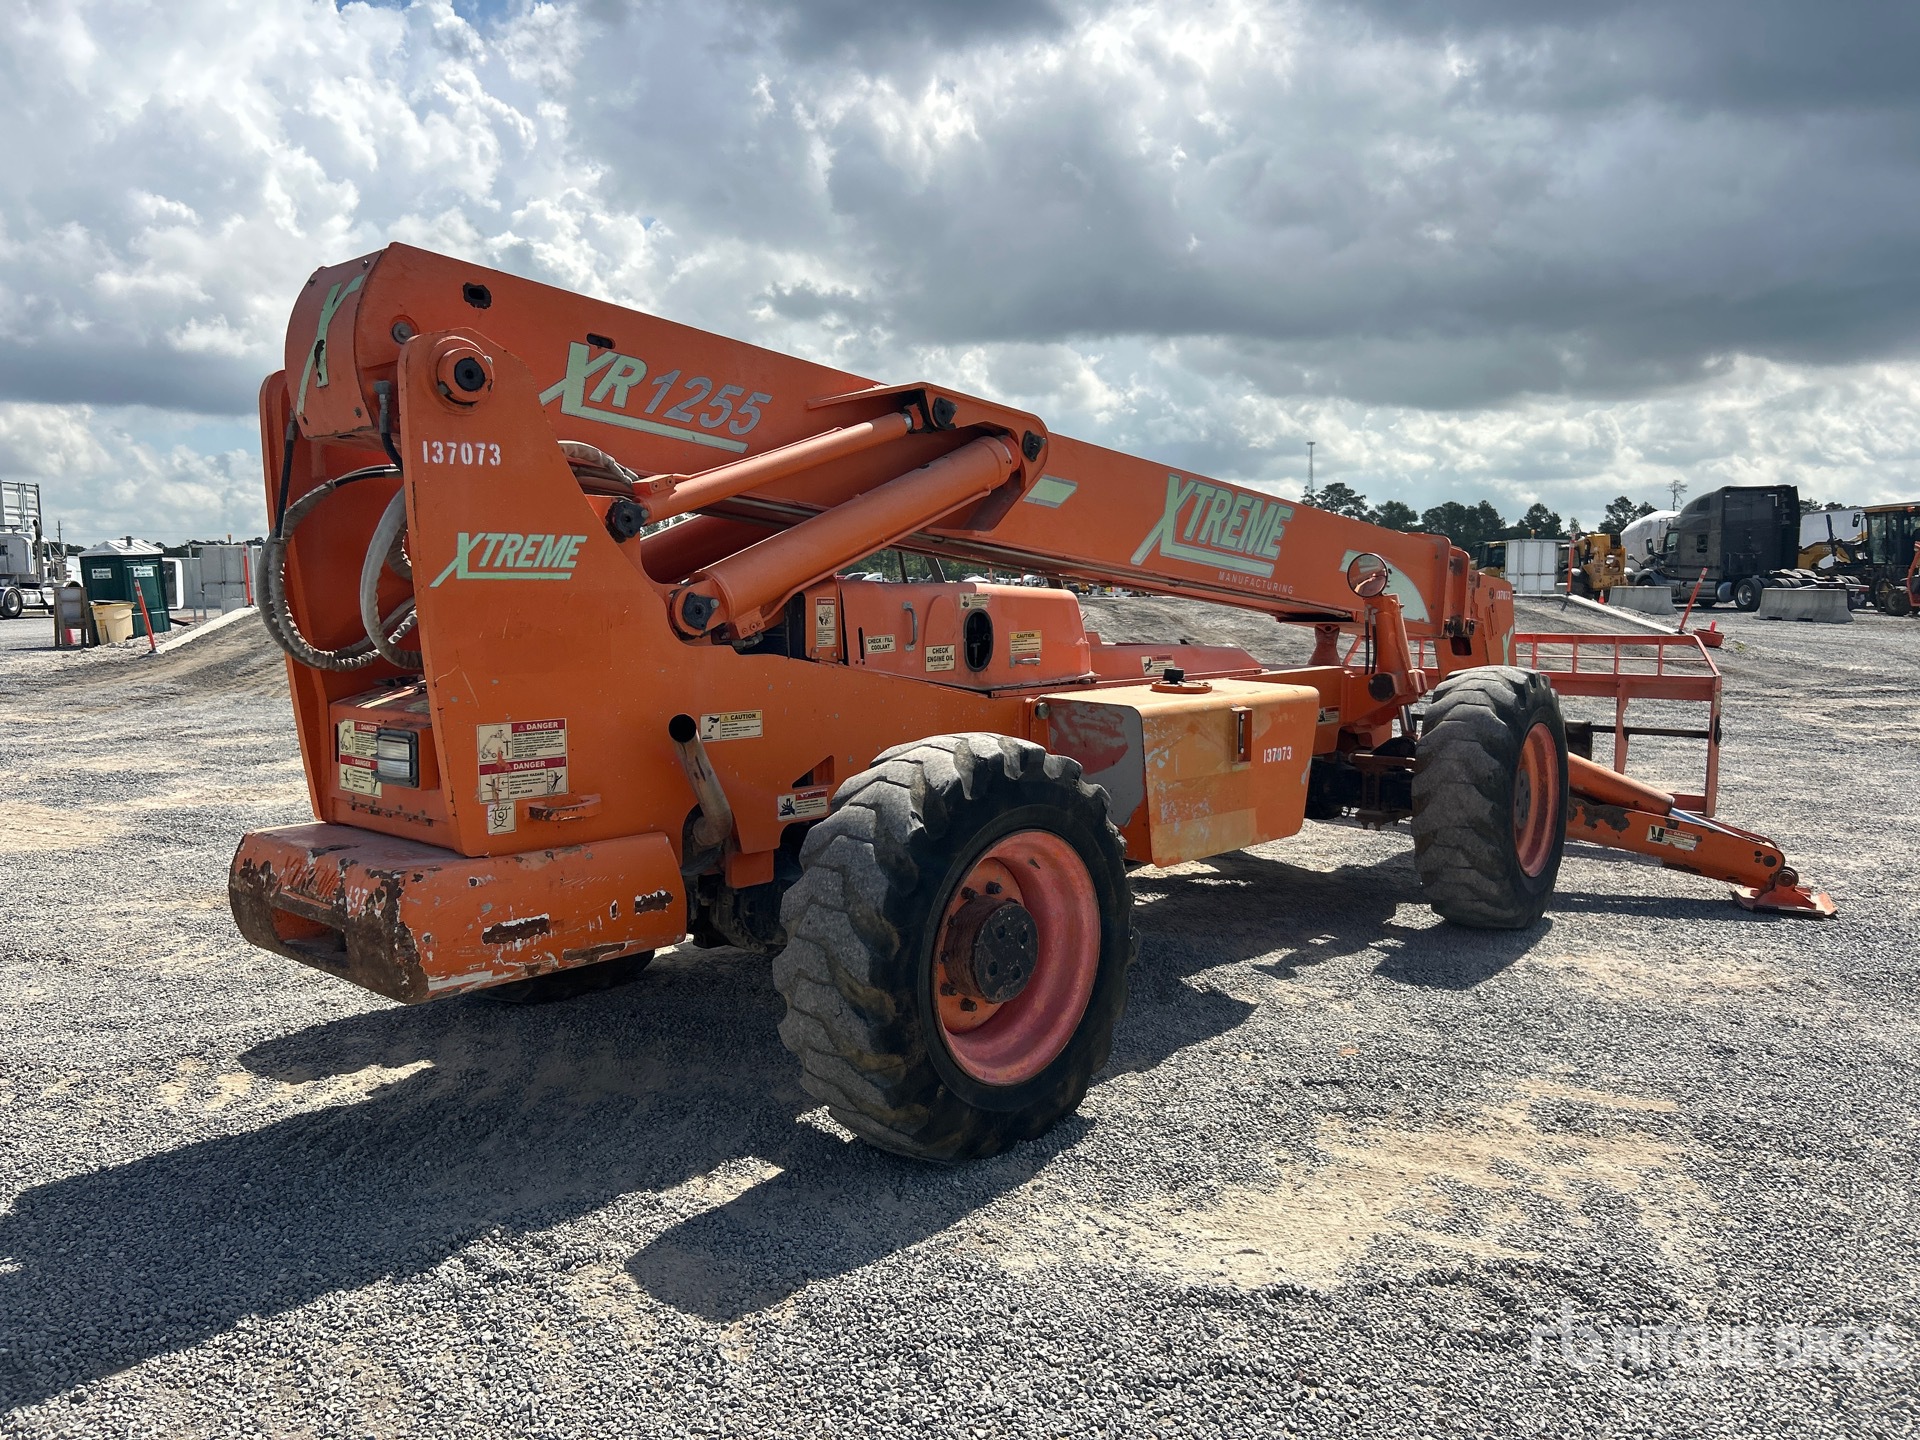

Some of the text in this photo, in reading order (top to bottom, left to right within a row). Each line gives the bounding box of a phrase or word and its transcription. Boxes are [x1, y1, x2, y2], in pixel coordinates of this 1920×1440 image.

[538, 341, 773, 435] XR 1255
[422, 440, 501, 466] 137073
[1130, 473, 1296, 567] XTREME
[429, 532, 588, 588] XTREME
[1218, 571, 1294, 595] MANUFACTURING
[927, 655, 945, 663] ENGINE
[360, 723, 377, 732] DANGER
[527, 721, 559, 731] DANGER
[1263, 745, 1292, 764] 137073
[354, 758, 371, 768] DANGER
[513, 760, 546, 770] DANGER
[1673, 831, 1695, 840] DANGER
